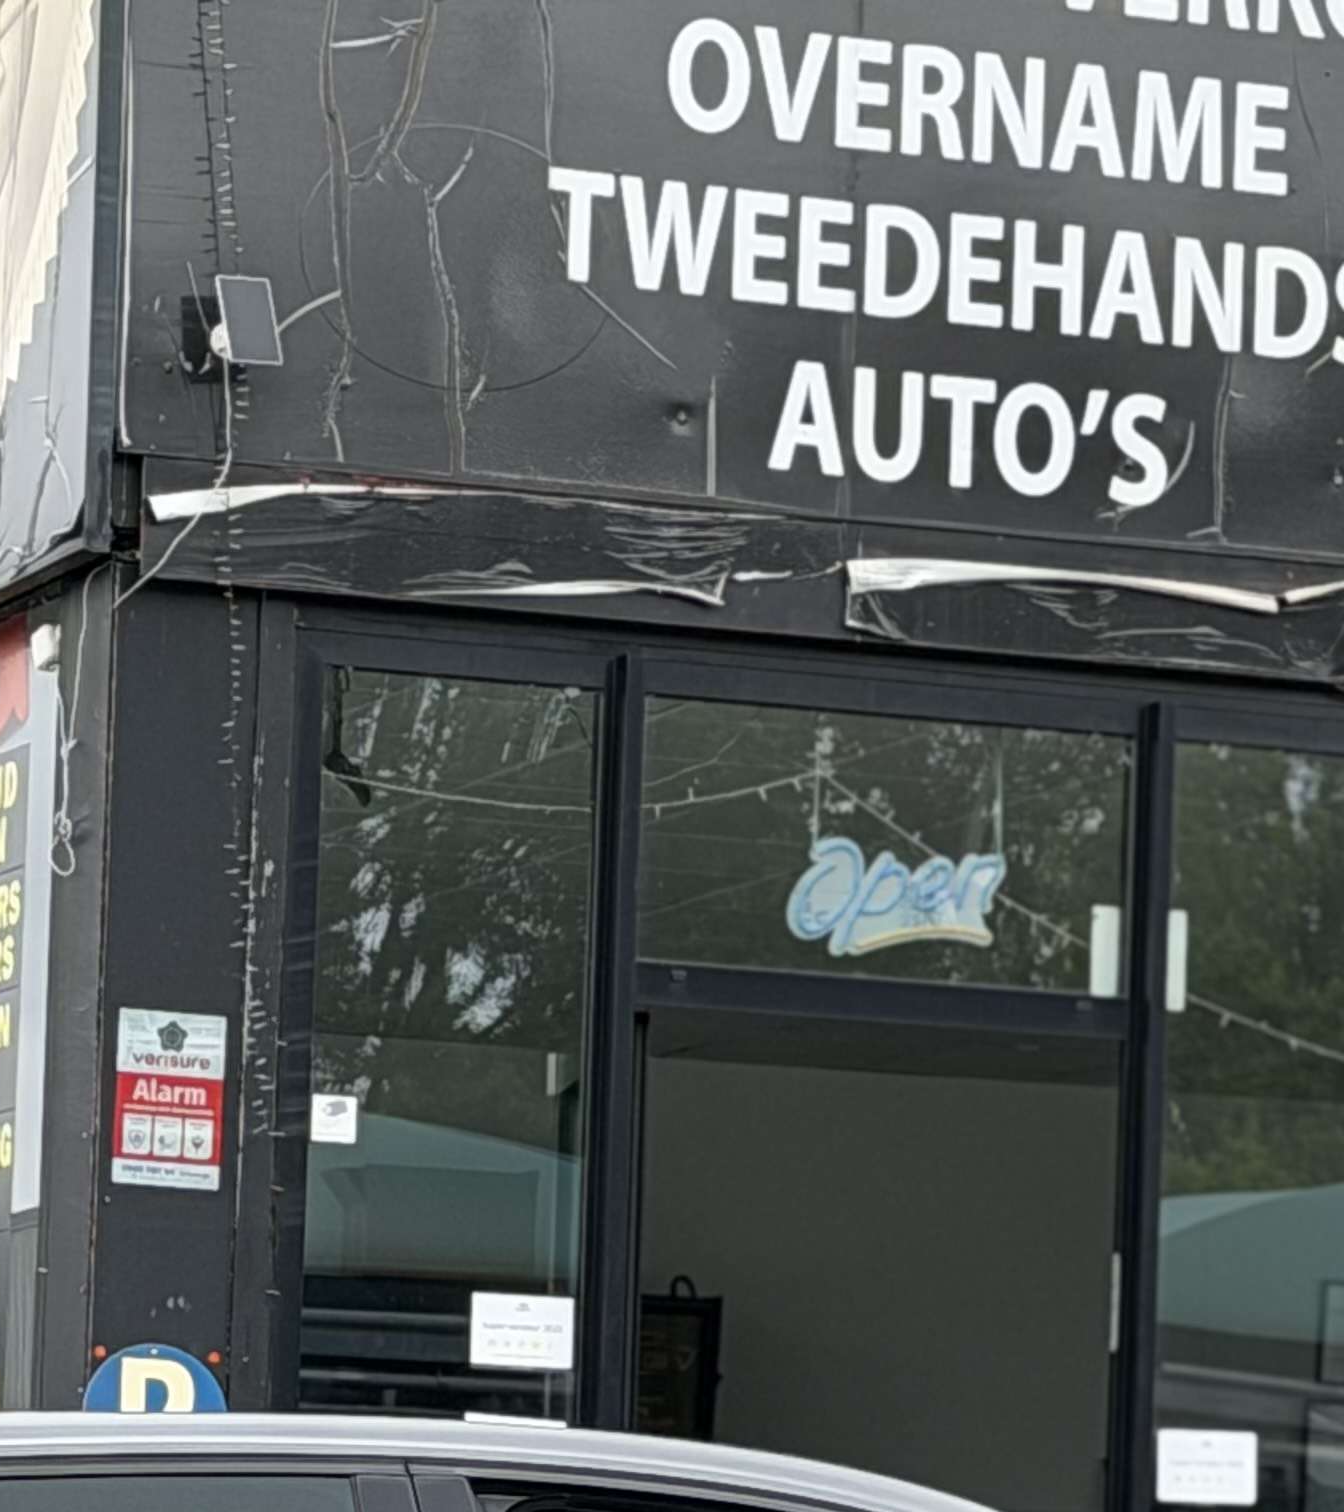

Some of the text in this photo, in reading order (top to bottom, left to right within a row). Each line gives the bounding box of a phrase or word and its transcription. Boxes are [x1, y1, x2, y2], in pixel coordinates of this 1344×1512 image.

[666, 17, 1290, 197] OVERNAME
[767, 360, 1170, 507] AUTO'S
[787, 836, 1005, 956] Open
[132, 1078, 208, 1106] Alarm
